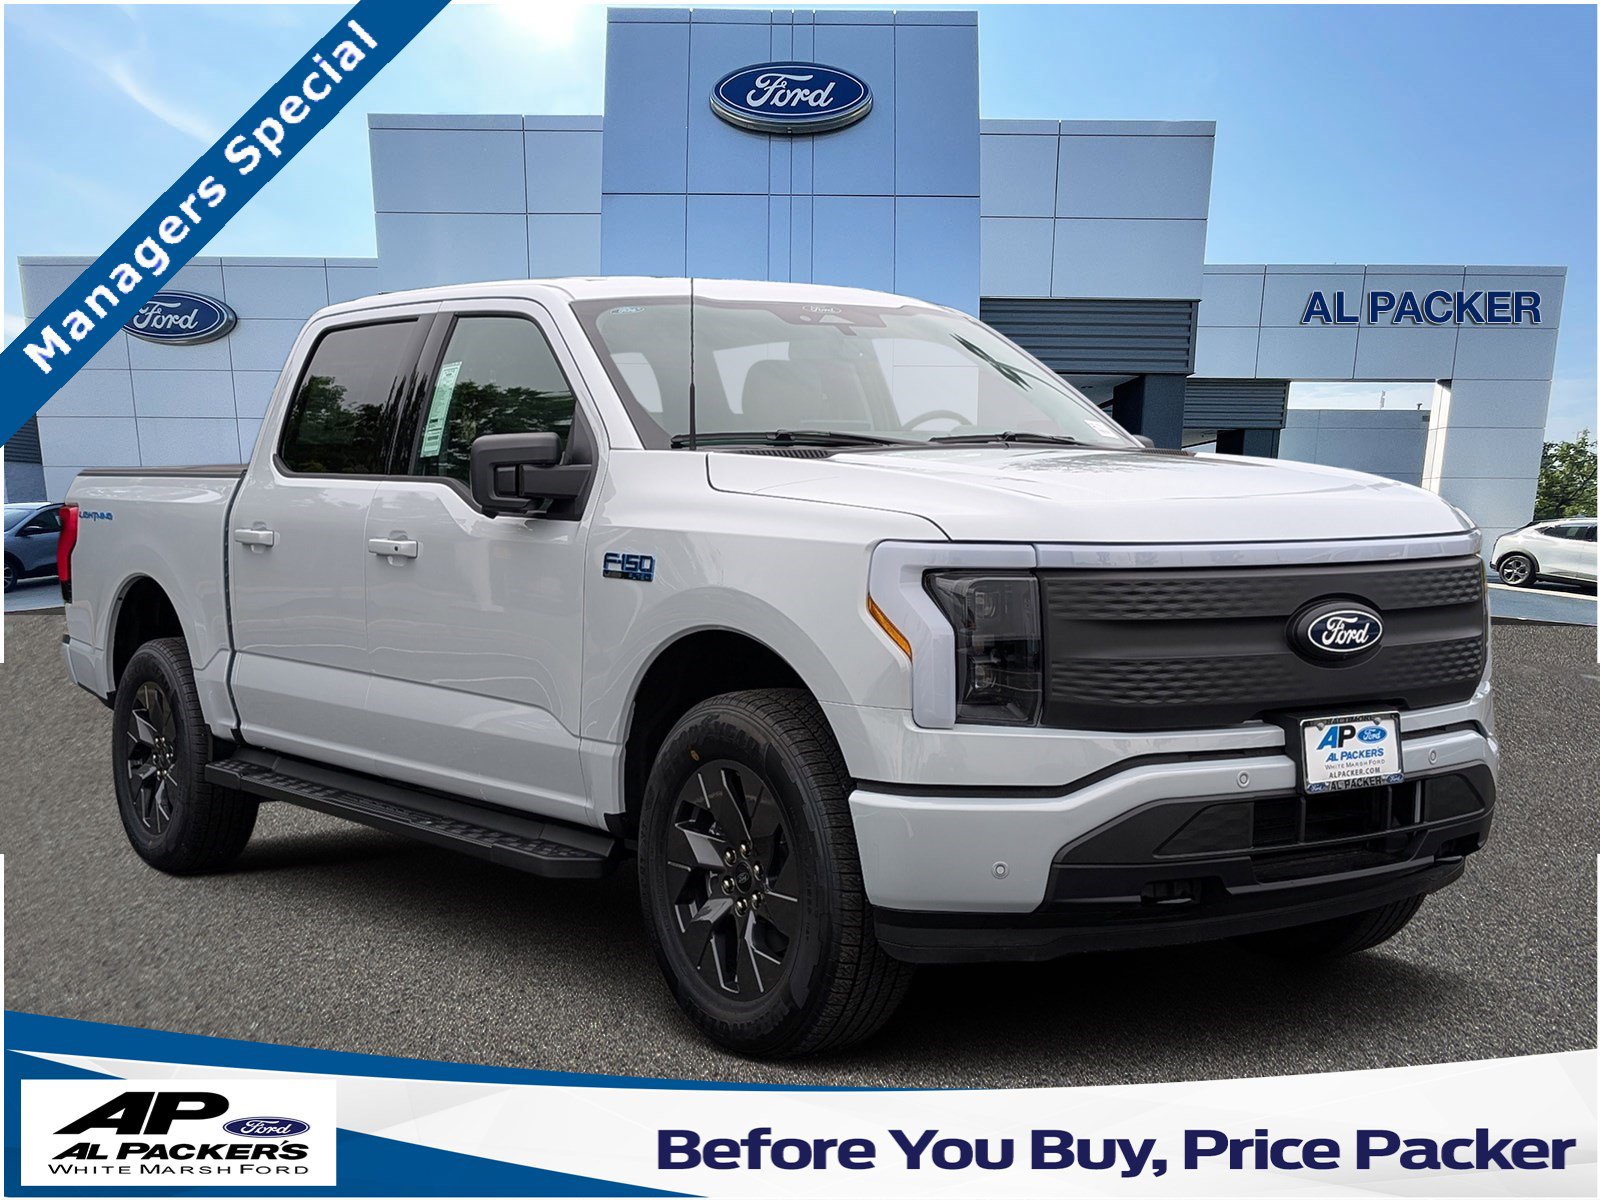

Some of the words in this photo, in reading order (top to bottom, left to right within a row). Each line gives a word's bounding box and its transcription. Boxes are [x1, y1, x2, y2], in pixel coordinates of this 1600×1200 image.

[746, 73, 836, 107] Ford
[133, 301, 198, 329] Ford
[1301, 290, 1360, 324] AL
[1368, 290, 1542, 325] PACKER
[1321, 616, 1370, 646] Ford
[1316, 725, 1356, 750] AP
[1362, 729, 1381, 740] Ford
[1325, 752, 1339, 762] AL
[1328, 767, 1381, 779] ALPACKER.COM
[1330, 780, 1342, 790] AL
[1344, 775, 1382, 788] PACKER
